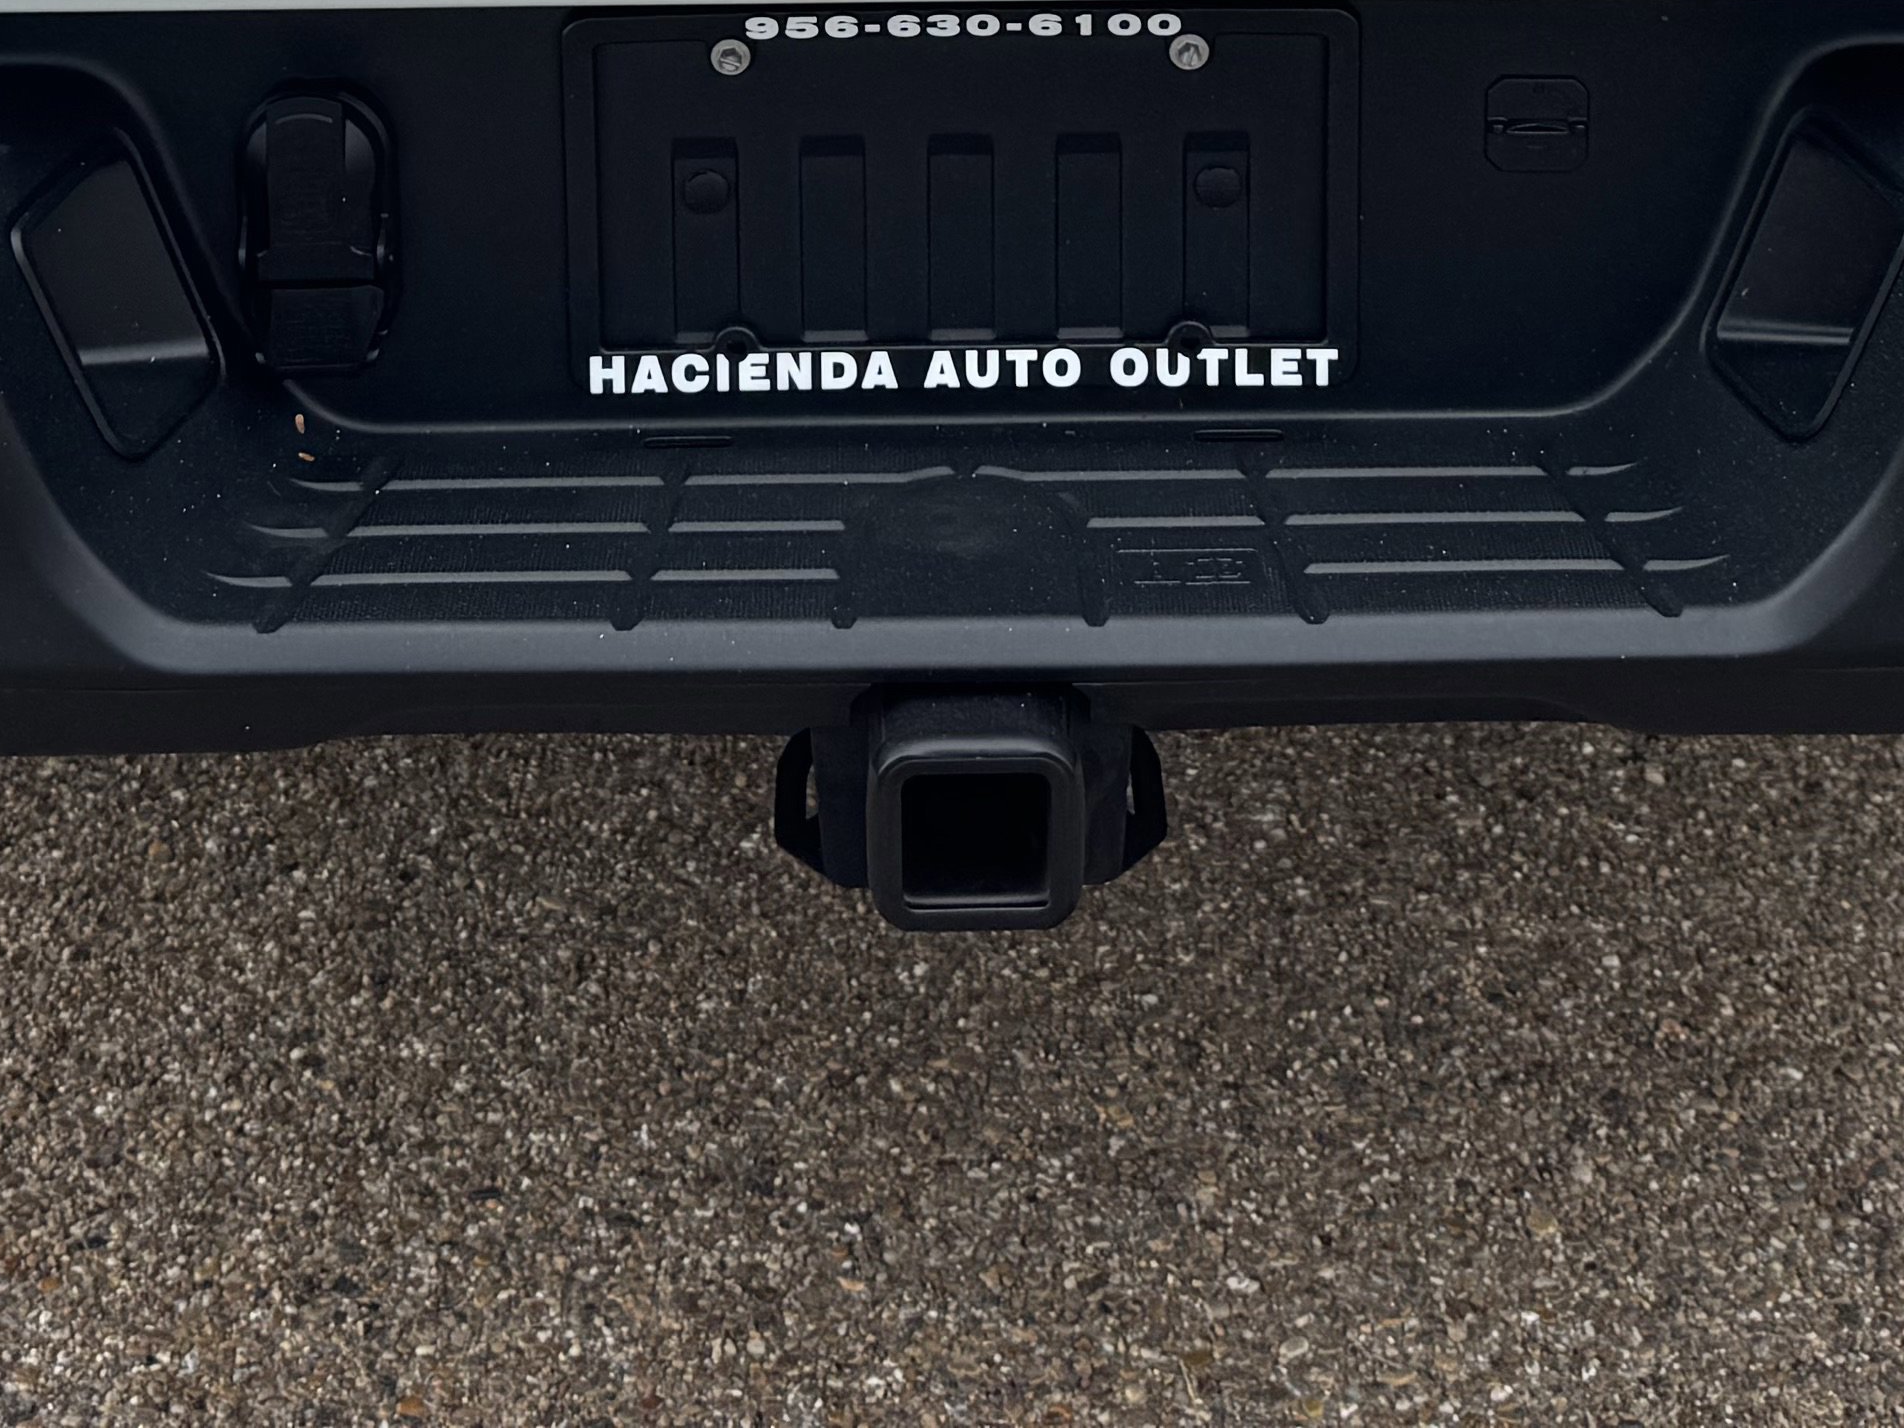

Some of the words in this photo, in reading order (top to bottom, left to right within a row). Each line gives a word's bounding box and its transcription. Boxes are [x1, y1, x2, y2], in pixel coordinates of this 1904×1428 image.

[744, 13, 1182, 40] 956-630-6100
[588, 352, 899, 395] HACIENDA
[923, 349, 1082, 389] AUTO
[1108, 346, 1339, 388] OUTLET
